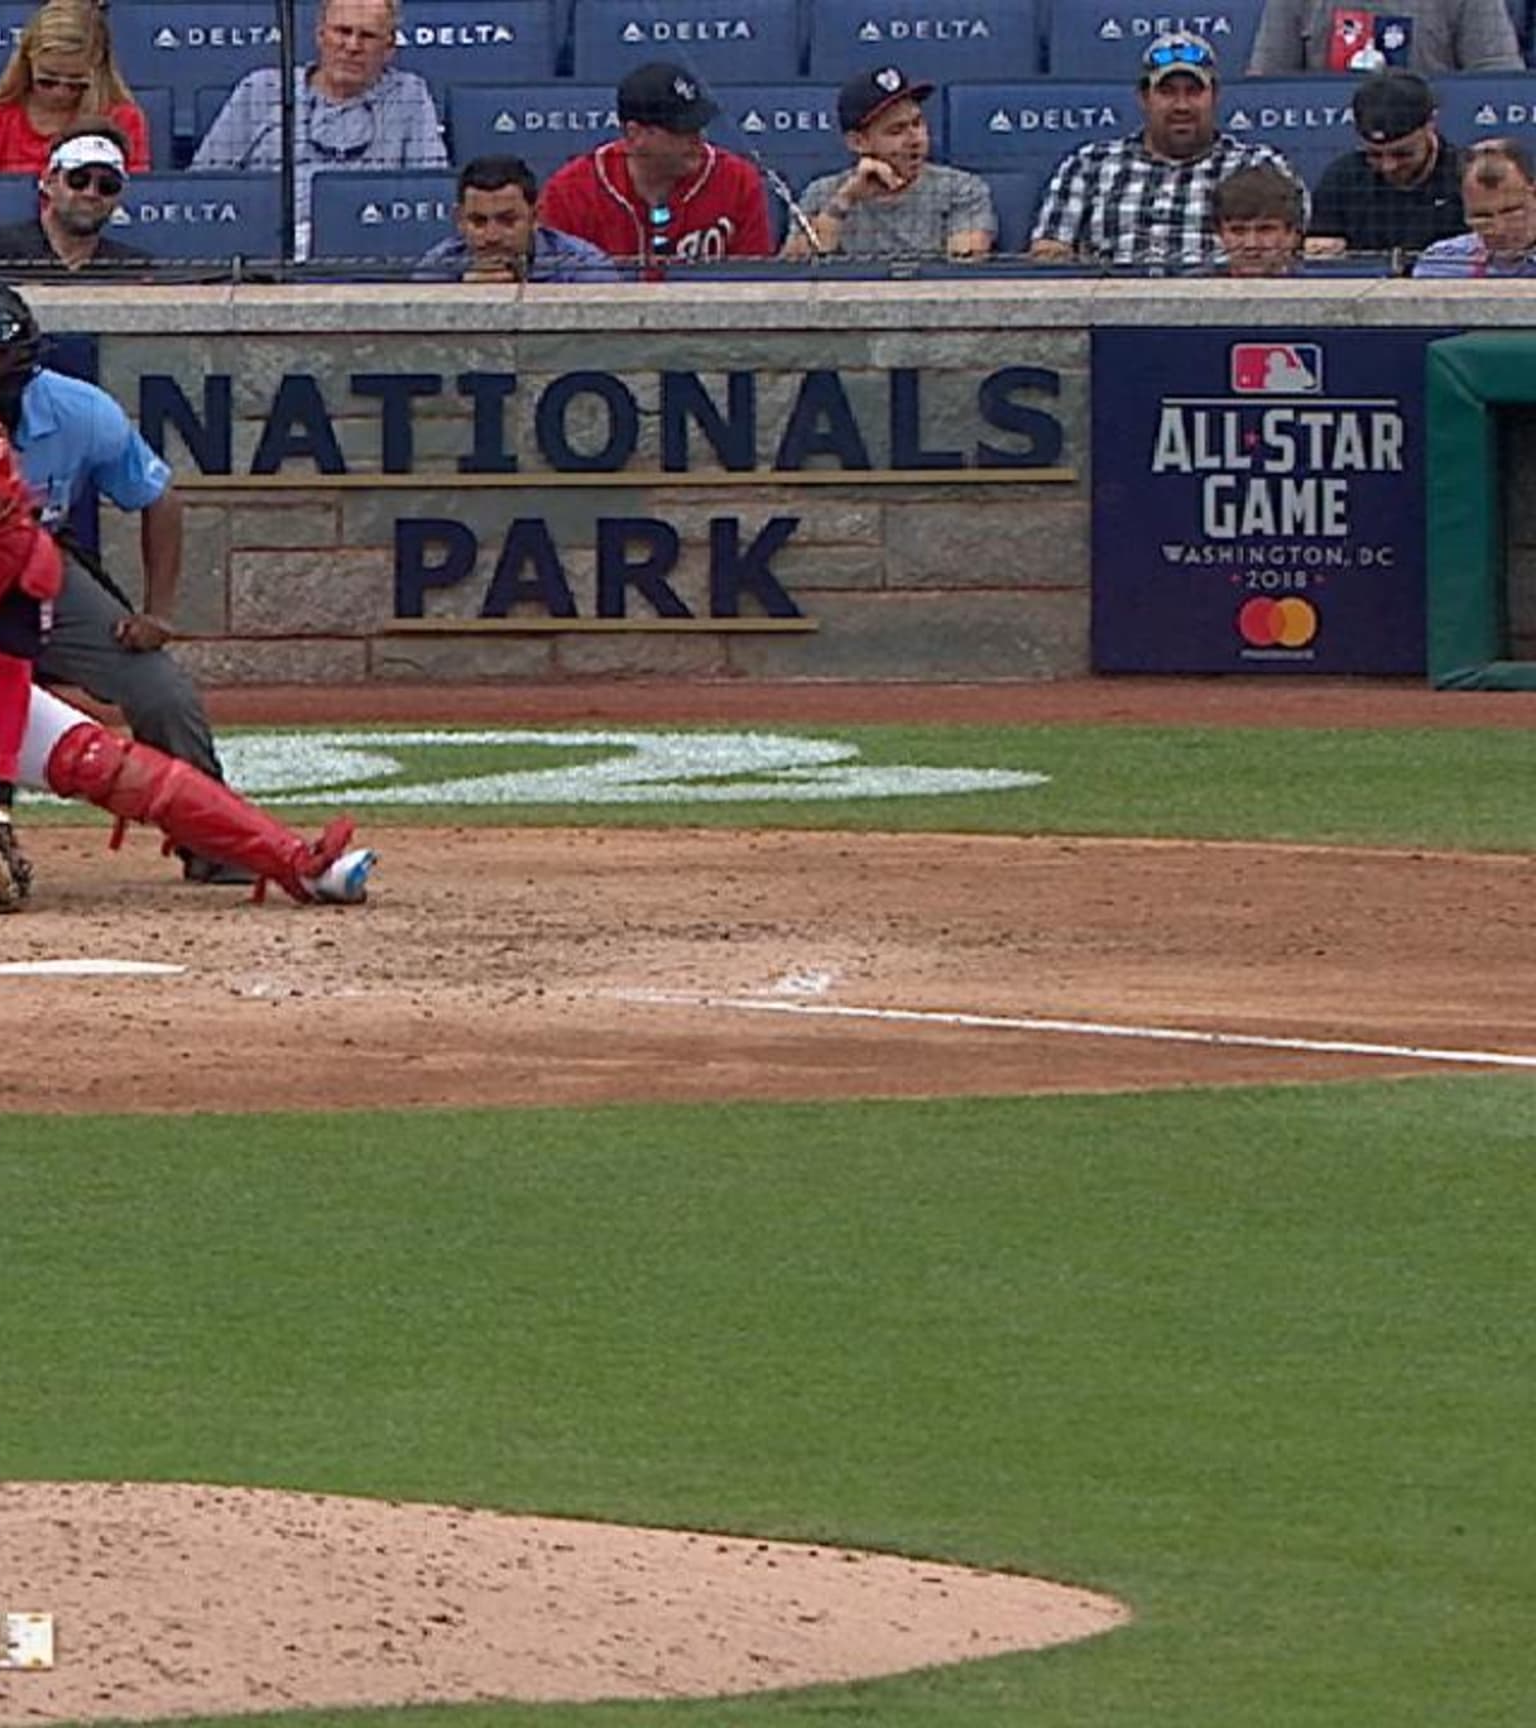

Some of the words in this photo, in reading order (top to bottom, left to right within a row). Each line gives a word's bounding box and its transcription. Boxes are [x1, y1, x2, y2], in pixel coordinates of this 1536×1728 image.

[187, 26, 282, 46] DELTA
[415, 25, 514, 45] DELTA
[653, 21, 752, 41] DELTA
[891, 19, 990, 40] DELTA
[1132, 16, 1232, 36] DELTA
[524, 111, 621, 131] DELTA
[774, 111, 832, 131] DEL
[1020, 107, 1117, 129] DELTA
[140, 203, 238, 223] DELTA
[137, 365, 1065, 478] NATIONALS
[1203, 475, 1350, 538] GAME
[1358, 547, 1395, 566] DC
[392, 516, 806, 621] PARK
[1246, 570, 1308, 589] 2018
